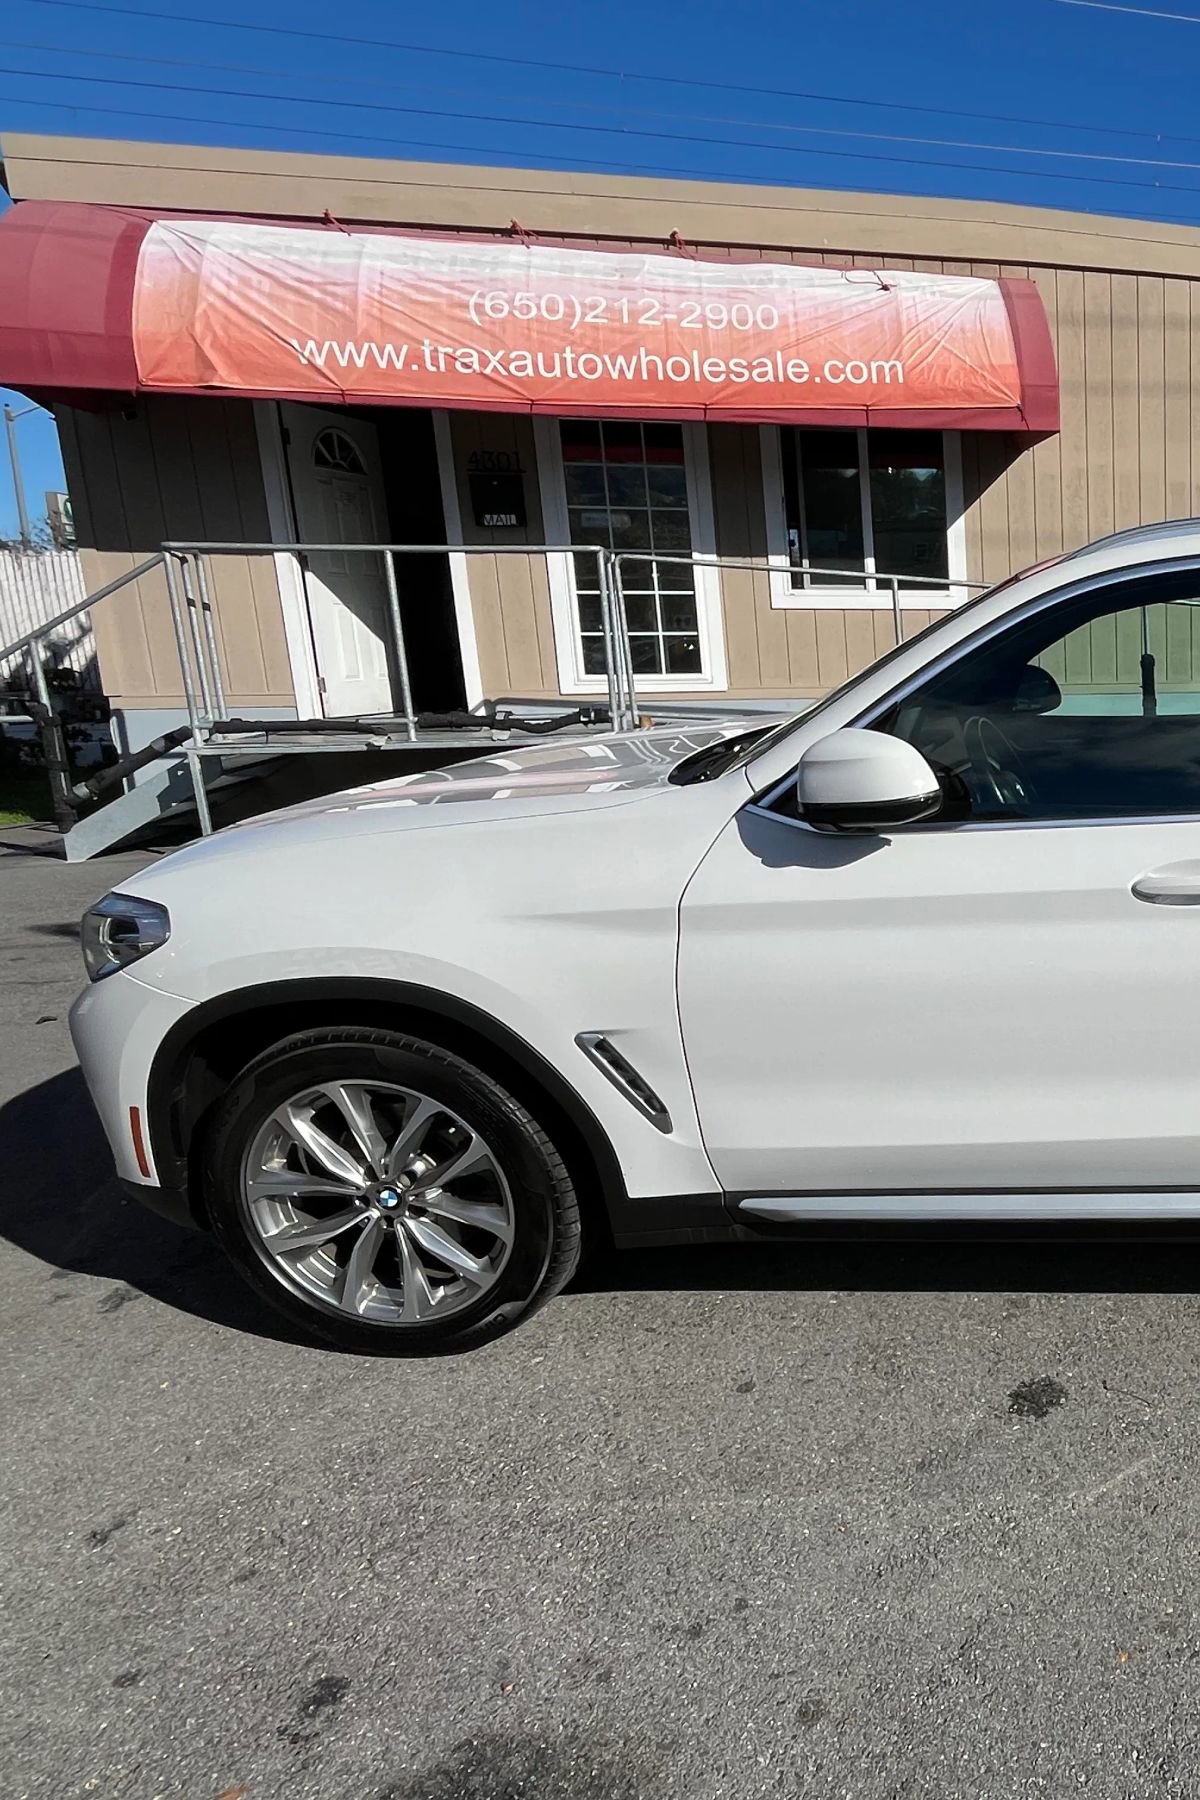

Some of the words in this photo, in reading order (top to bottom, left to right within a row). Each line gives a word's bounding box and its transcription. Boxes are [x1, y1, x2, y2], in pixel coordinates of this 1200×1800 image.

[468, 290, 779, 330] (650)212-2900
[291, 337, 904, 384] www.traxautowholesale.com
[484, 513, 518, 527] MAIL
